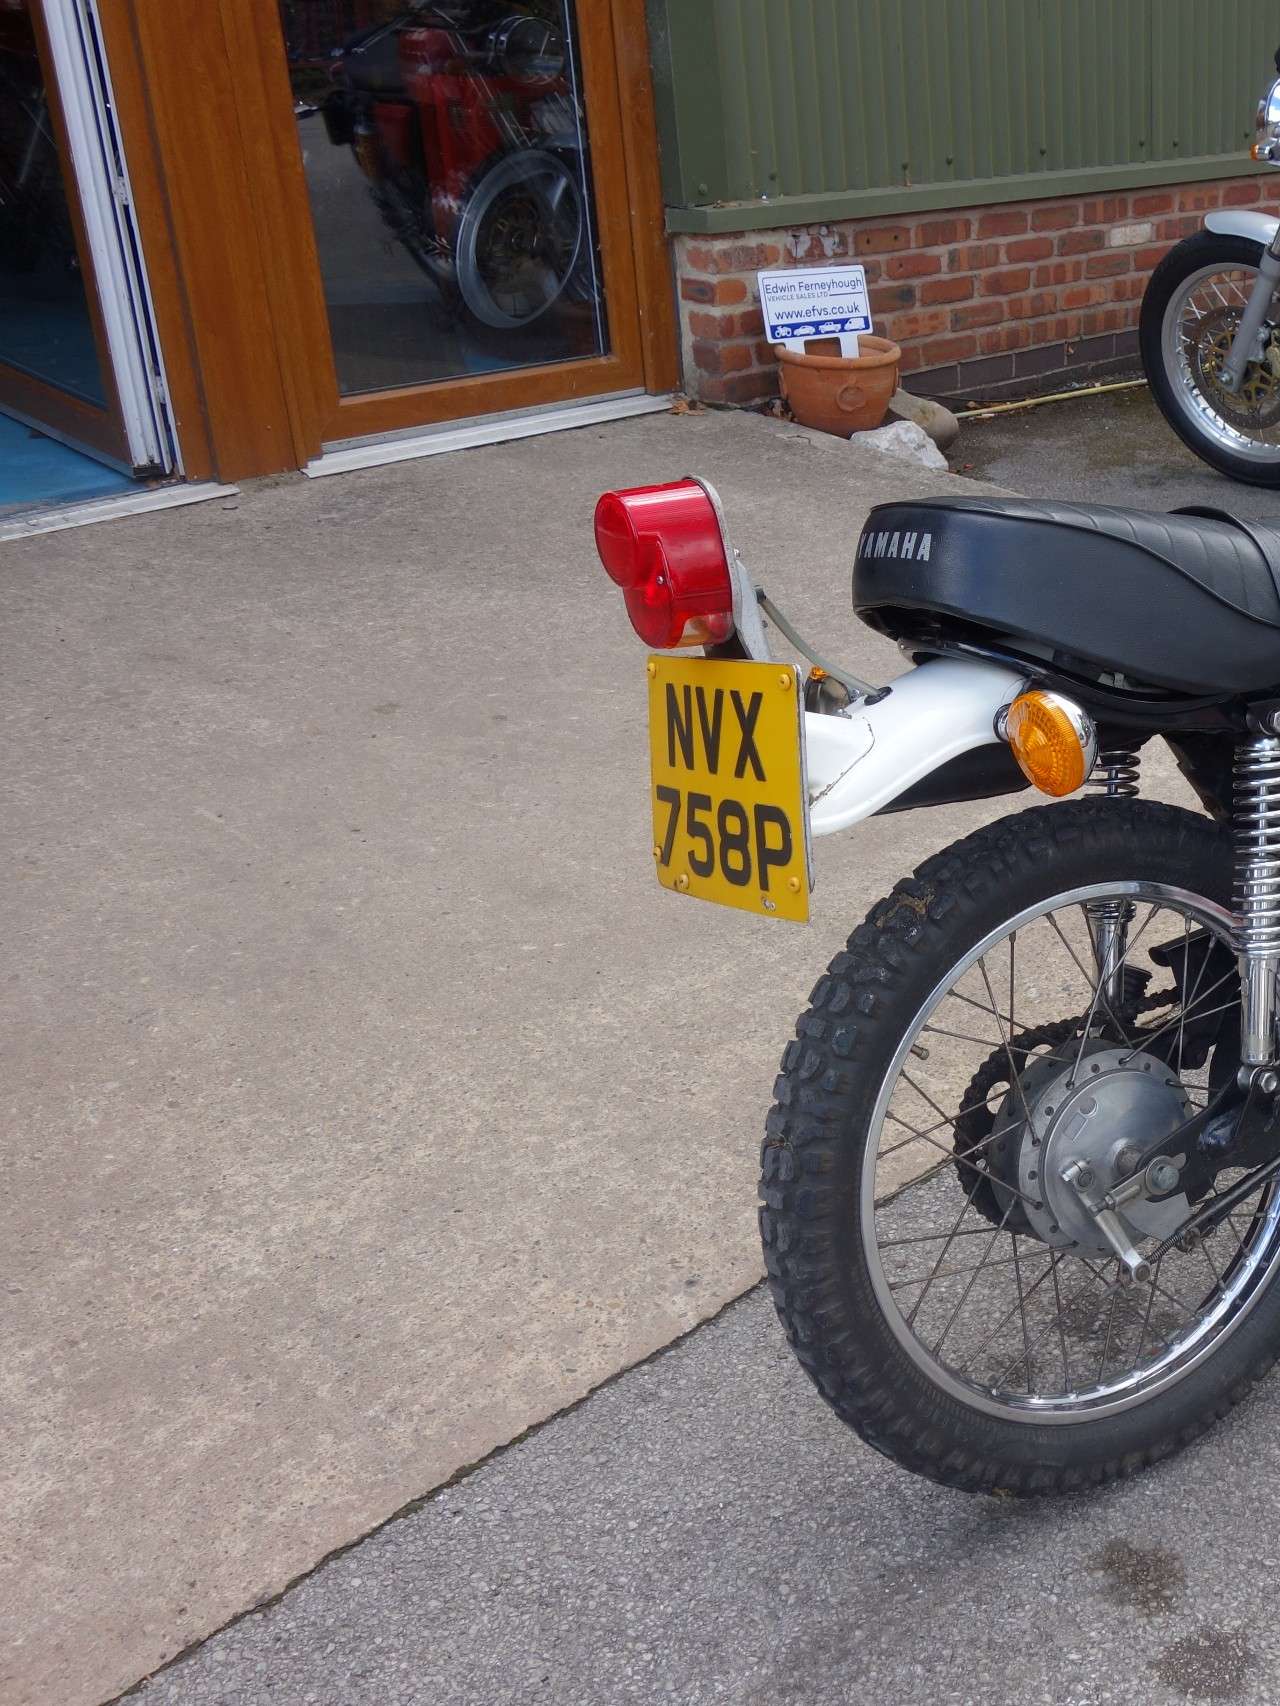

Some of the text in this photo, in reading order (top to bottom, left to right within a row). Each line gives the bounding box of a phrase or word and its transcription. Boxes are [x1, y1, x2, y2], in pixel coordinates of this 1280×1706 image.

[765, 277, 862, 294] Edwin Ferneyhough
[767, 293, 794, 302] VEHICLE
[796, 292, 816, 300] SALES
[774, 302, 861, 320] www.efvs.co.uk
[859, 531, 932, 562] YAMAHA
[665, 683, 767, 782] NVX
[655, 785, 792, 892] 758P
